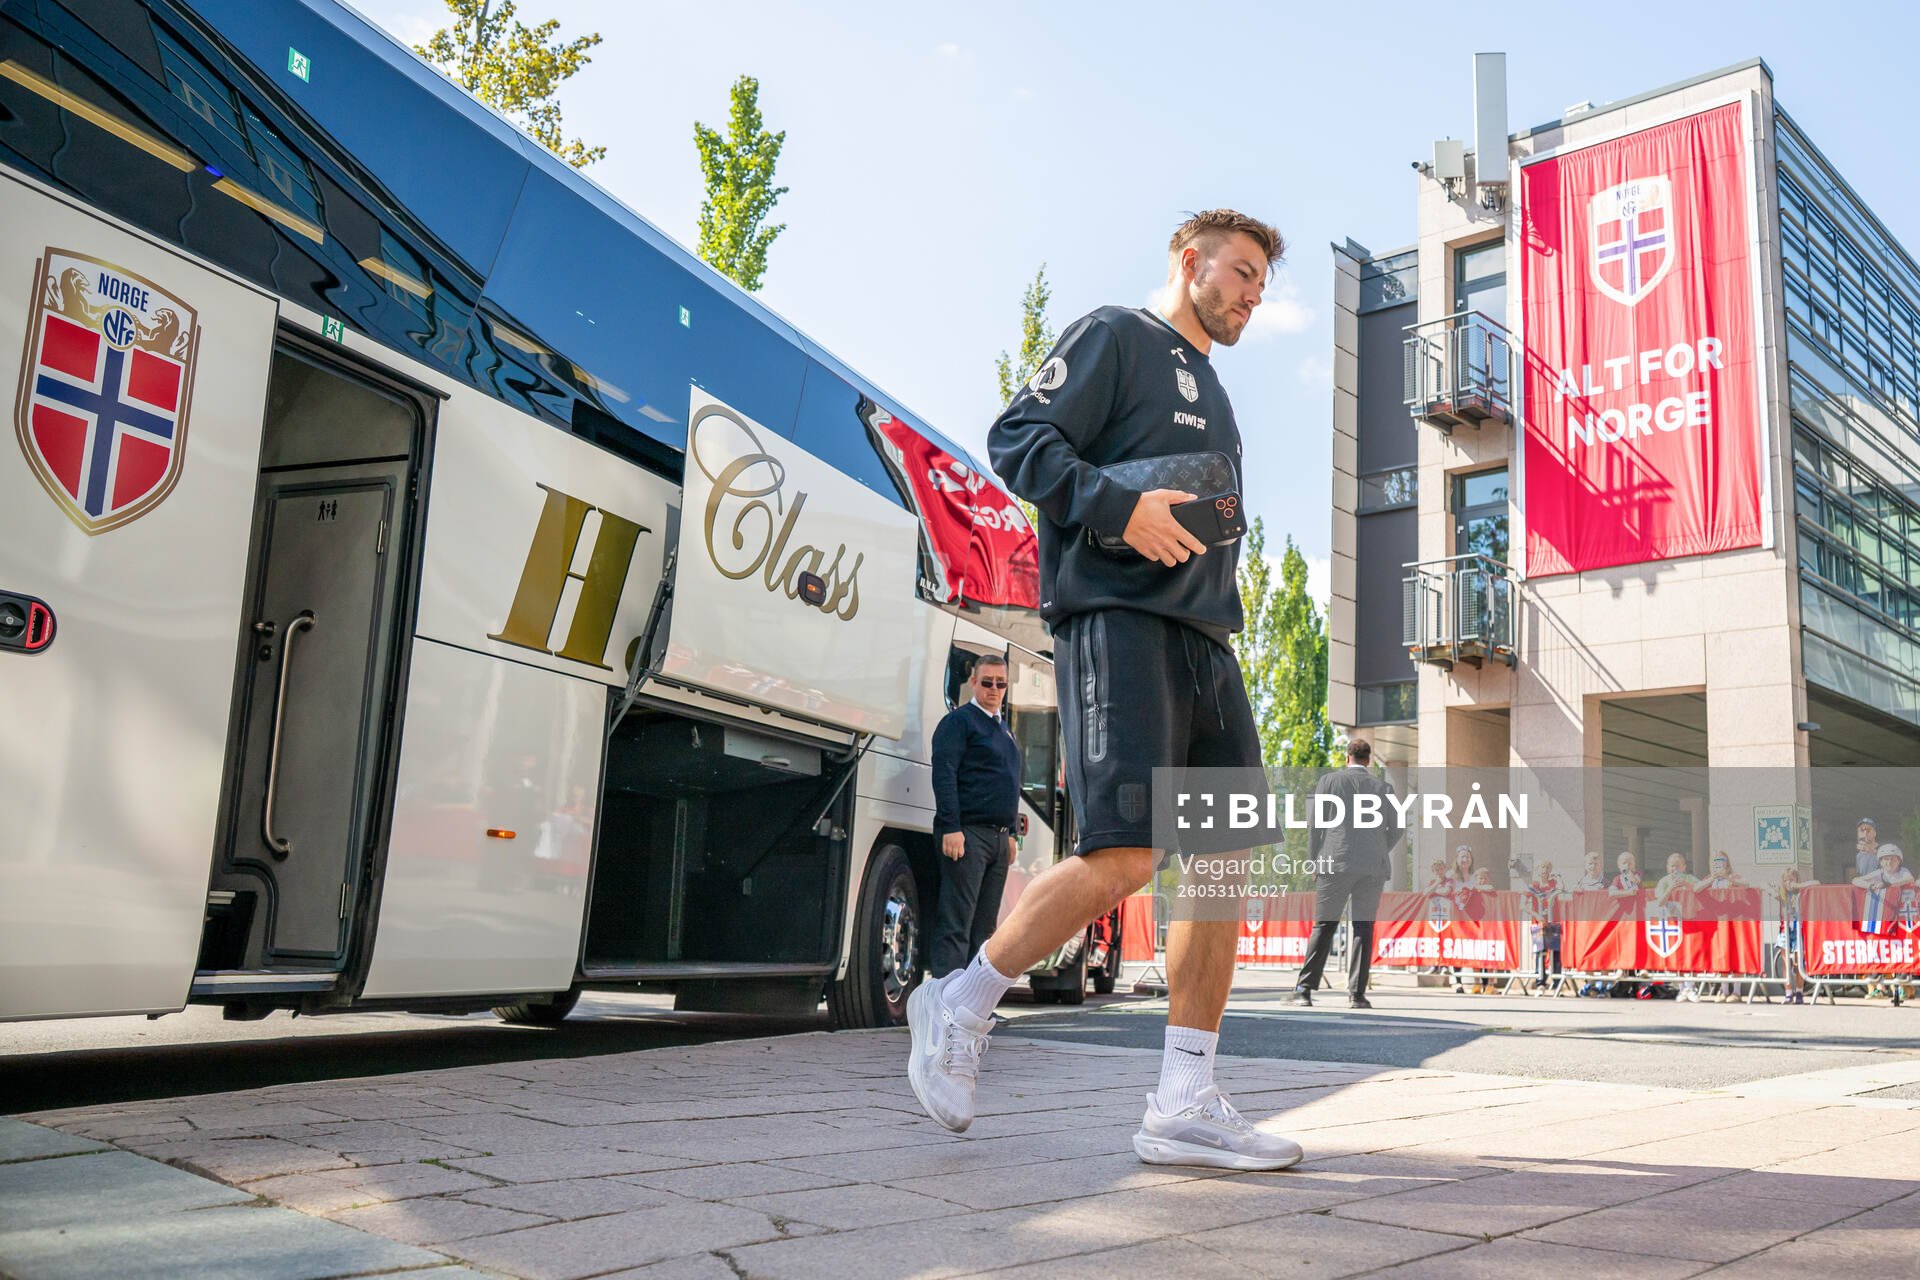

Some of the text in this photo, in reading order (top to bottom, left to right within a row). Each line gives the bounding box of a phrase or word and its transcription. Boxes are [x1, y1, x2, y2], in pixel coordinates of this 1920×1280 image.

[98, 272, 149, 312] NORGE
[103, 310, 135, 345] NFF
[1554, 336, 1724, 403] ALT FOR
[1173, 411, 1197, 428] KIWI
[1568, 390, 1711, 449] NORGE
[690, 404, 863, 621] Class
[1379, 937, 1506, 961] STERKERE SAMMEN
[1822, 939, 1914, 965] STERKERE
